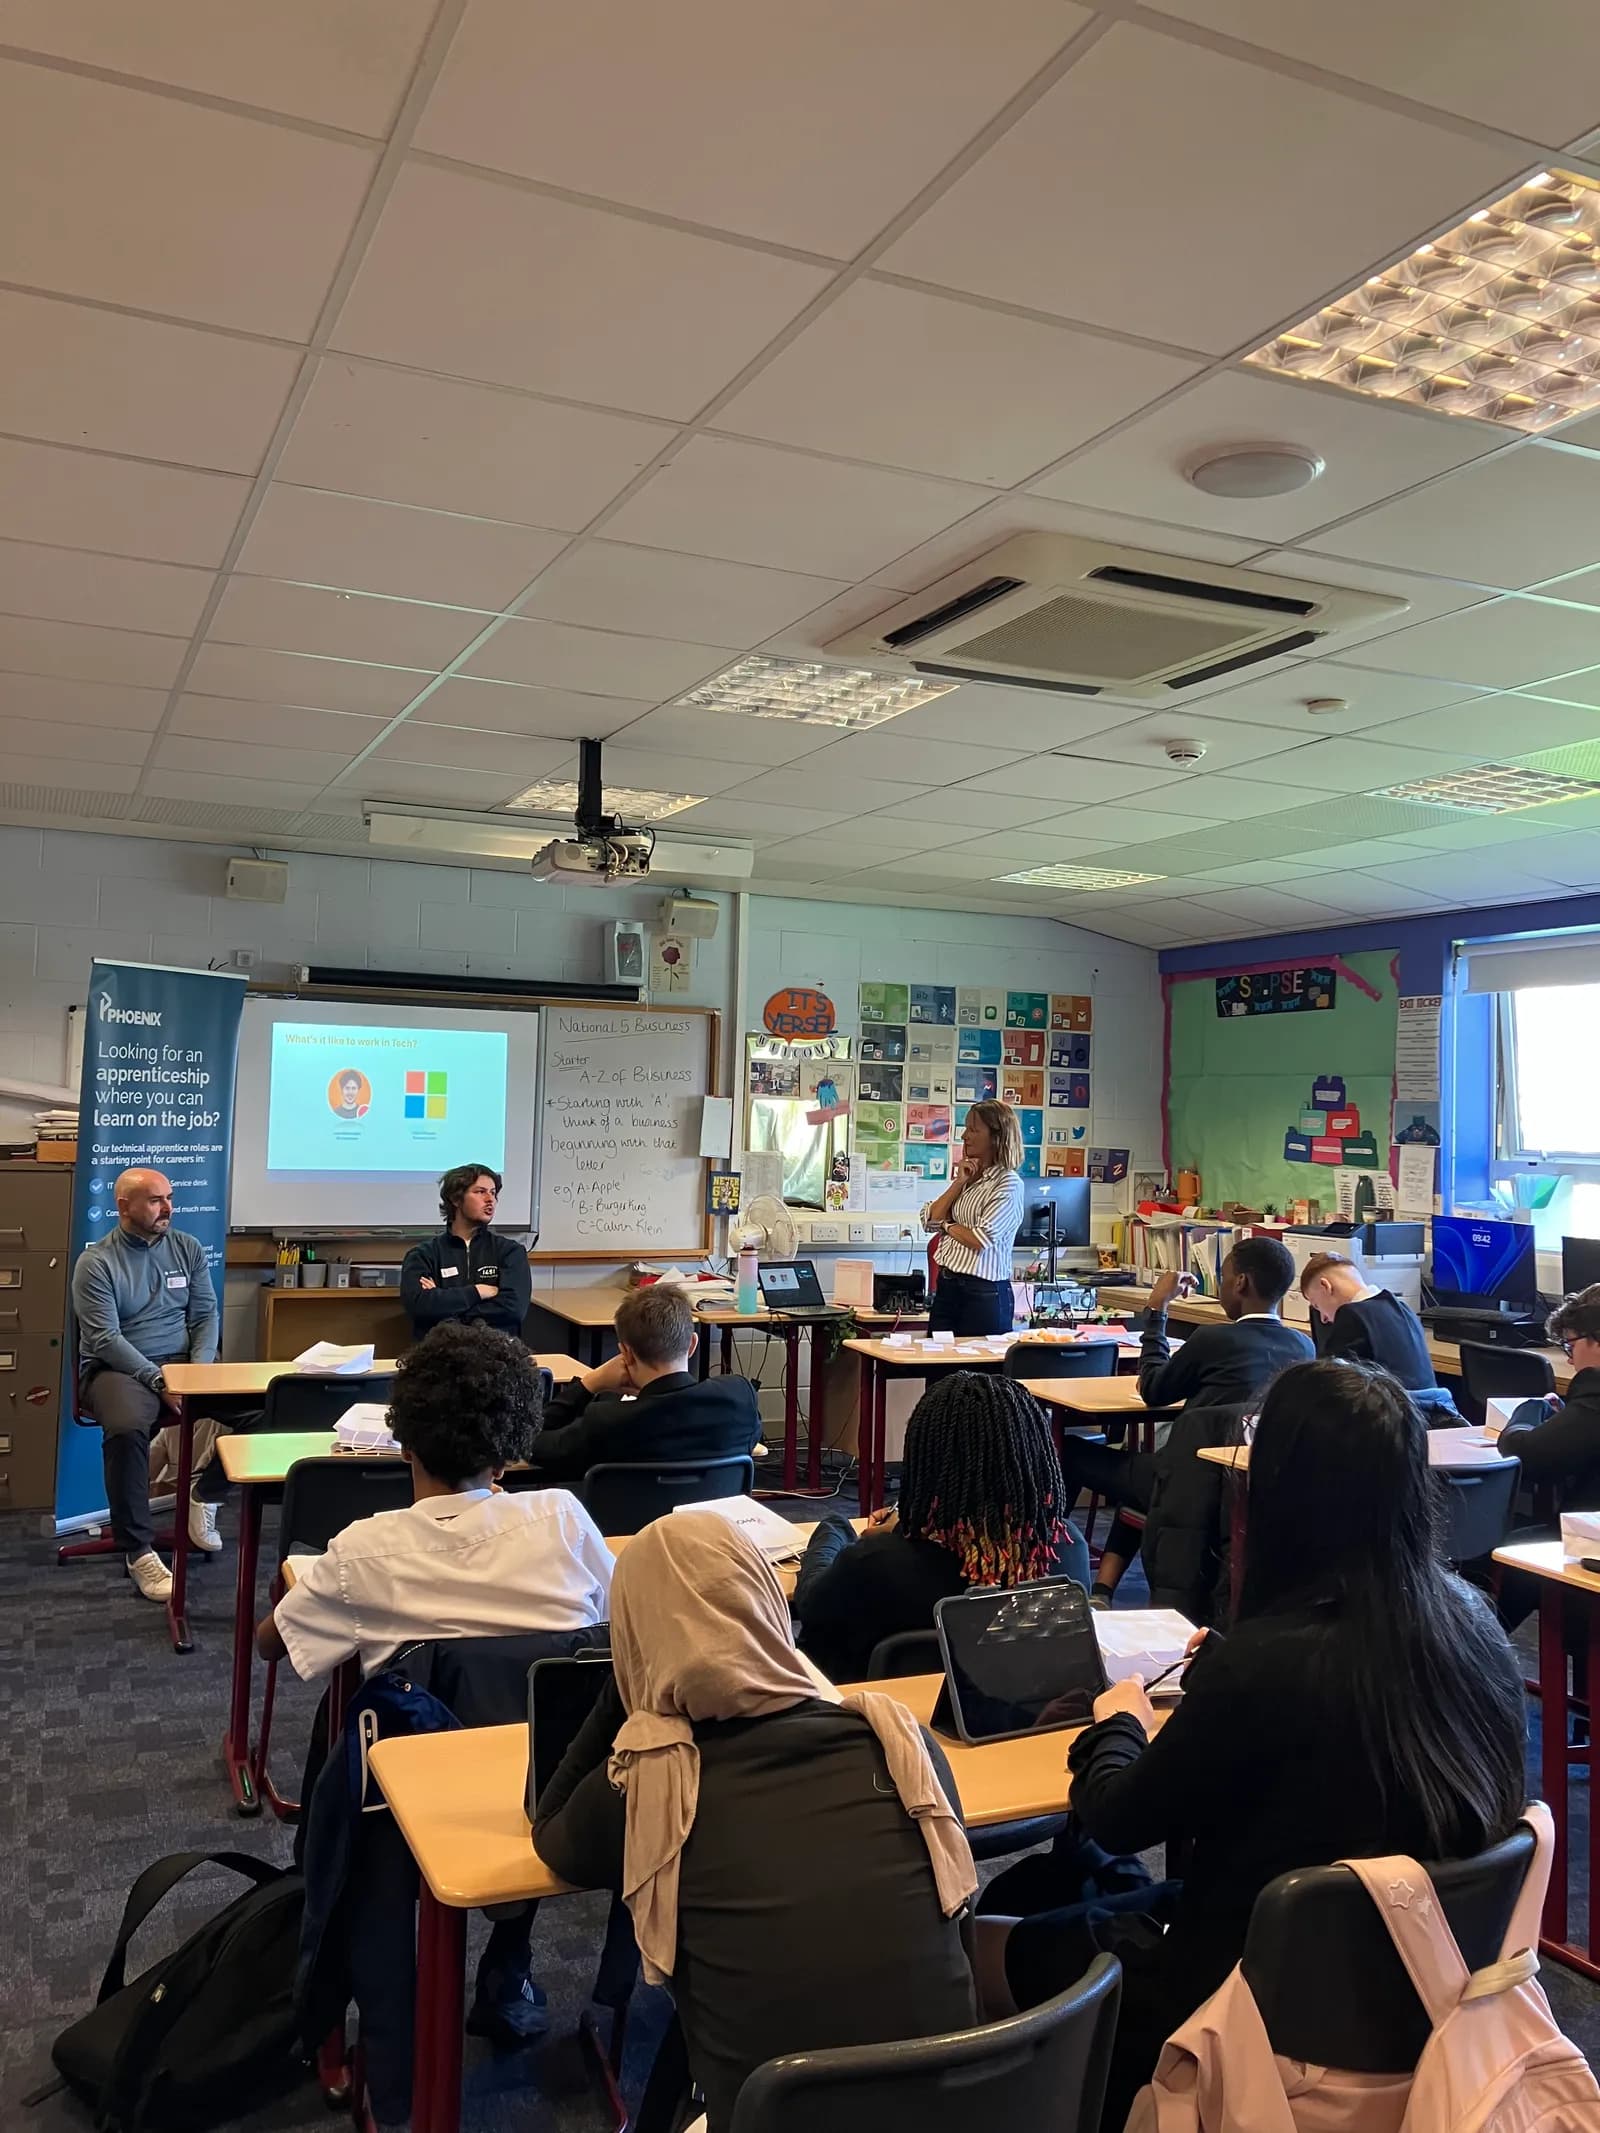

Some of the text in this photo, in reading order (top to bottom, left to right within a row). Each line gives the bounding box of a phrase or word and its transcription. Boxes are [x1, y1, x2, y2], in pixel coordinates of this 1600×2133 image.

[107, 1008, 162, 1027] PHOENIX
[560, 1016, 691, 1034] National 5 Business
[285, 1033, 318, 1045] What's
[328, 1035, 345, 1046] like
[346, 1037, 356, 1046] to
[358, 1038, 380, 1047] work
[98, 1041, 203, 1065] Looking for an
[552, 1051, 591, 1067] Starter
[96, 1066, 210, 1089] apprenticeship
[611, 1069, 628, 1086] of
[633, 1066, 692, 1082] Business
[95, 1087, 204, 1109] where you can
[616, 1097, 644, 1109] with
[93, 1109, 220, 1131] learn on the job?
[563, 1113, 679, 1134] think of a business
[92, 1144, 110, 1154] Our
[111, 1143, 146, 1153] technical
[146, 1144, 189, 1155] apprentice
[190, 1144, 210, 1153] roles
[550, 1134, 678, 1160] beginning with that
[91, 1154, 206, 1167] a starting point for careers in:
[576, 1156, 605, 1171] letter
[182, 1206, 199, 1214] much
